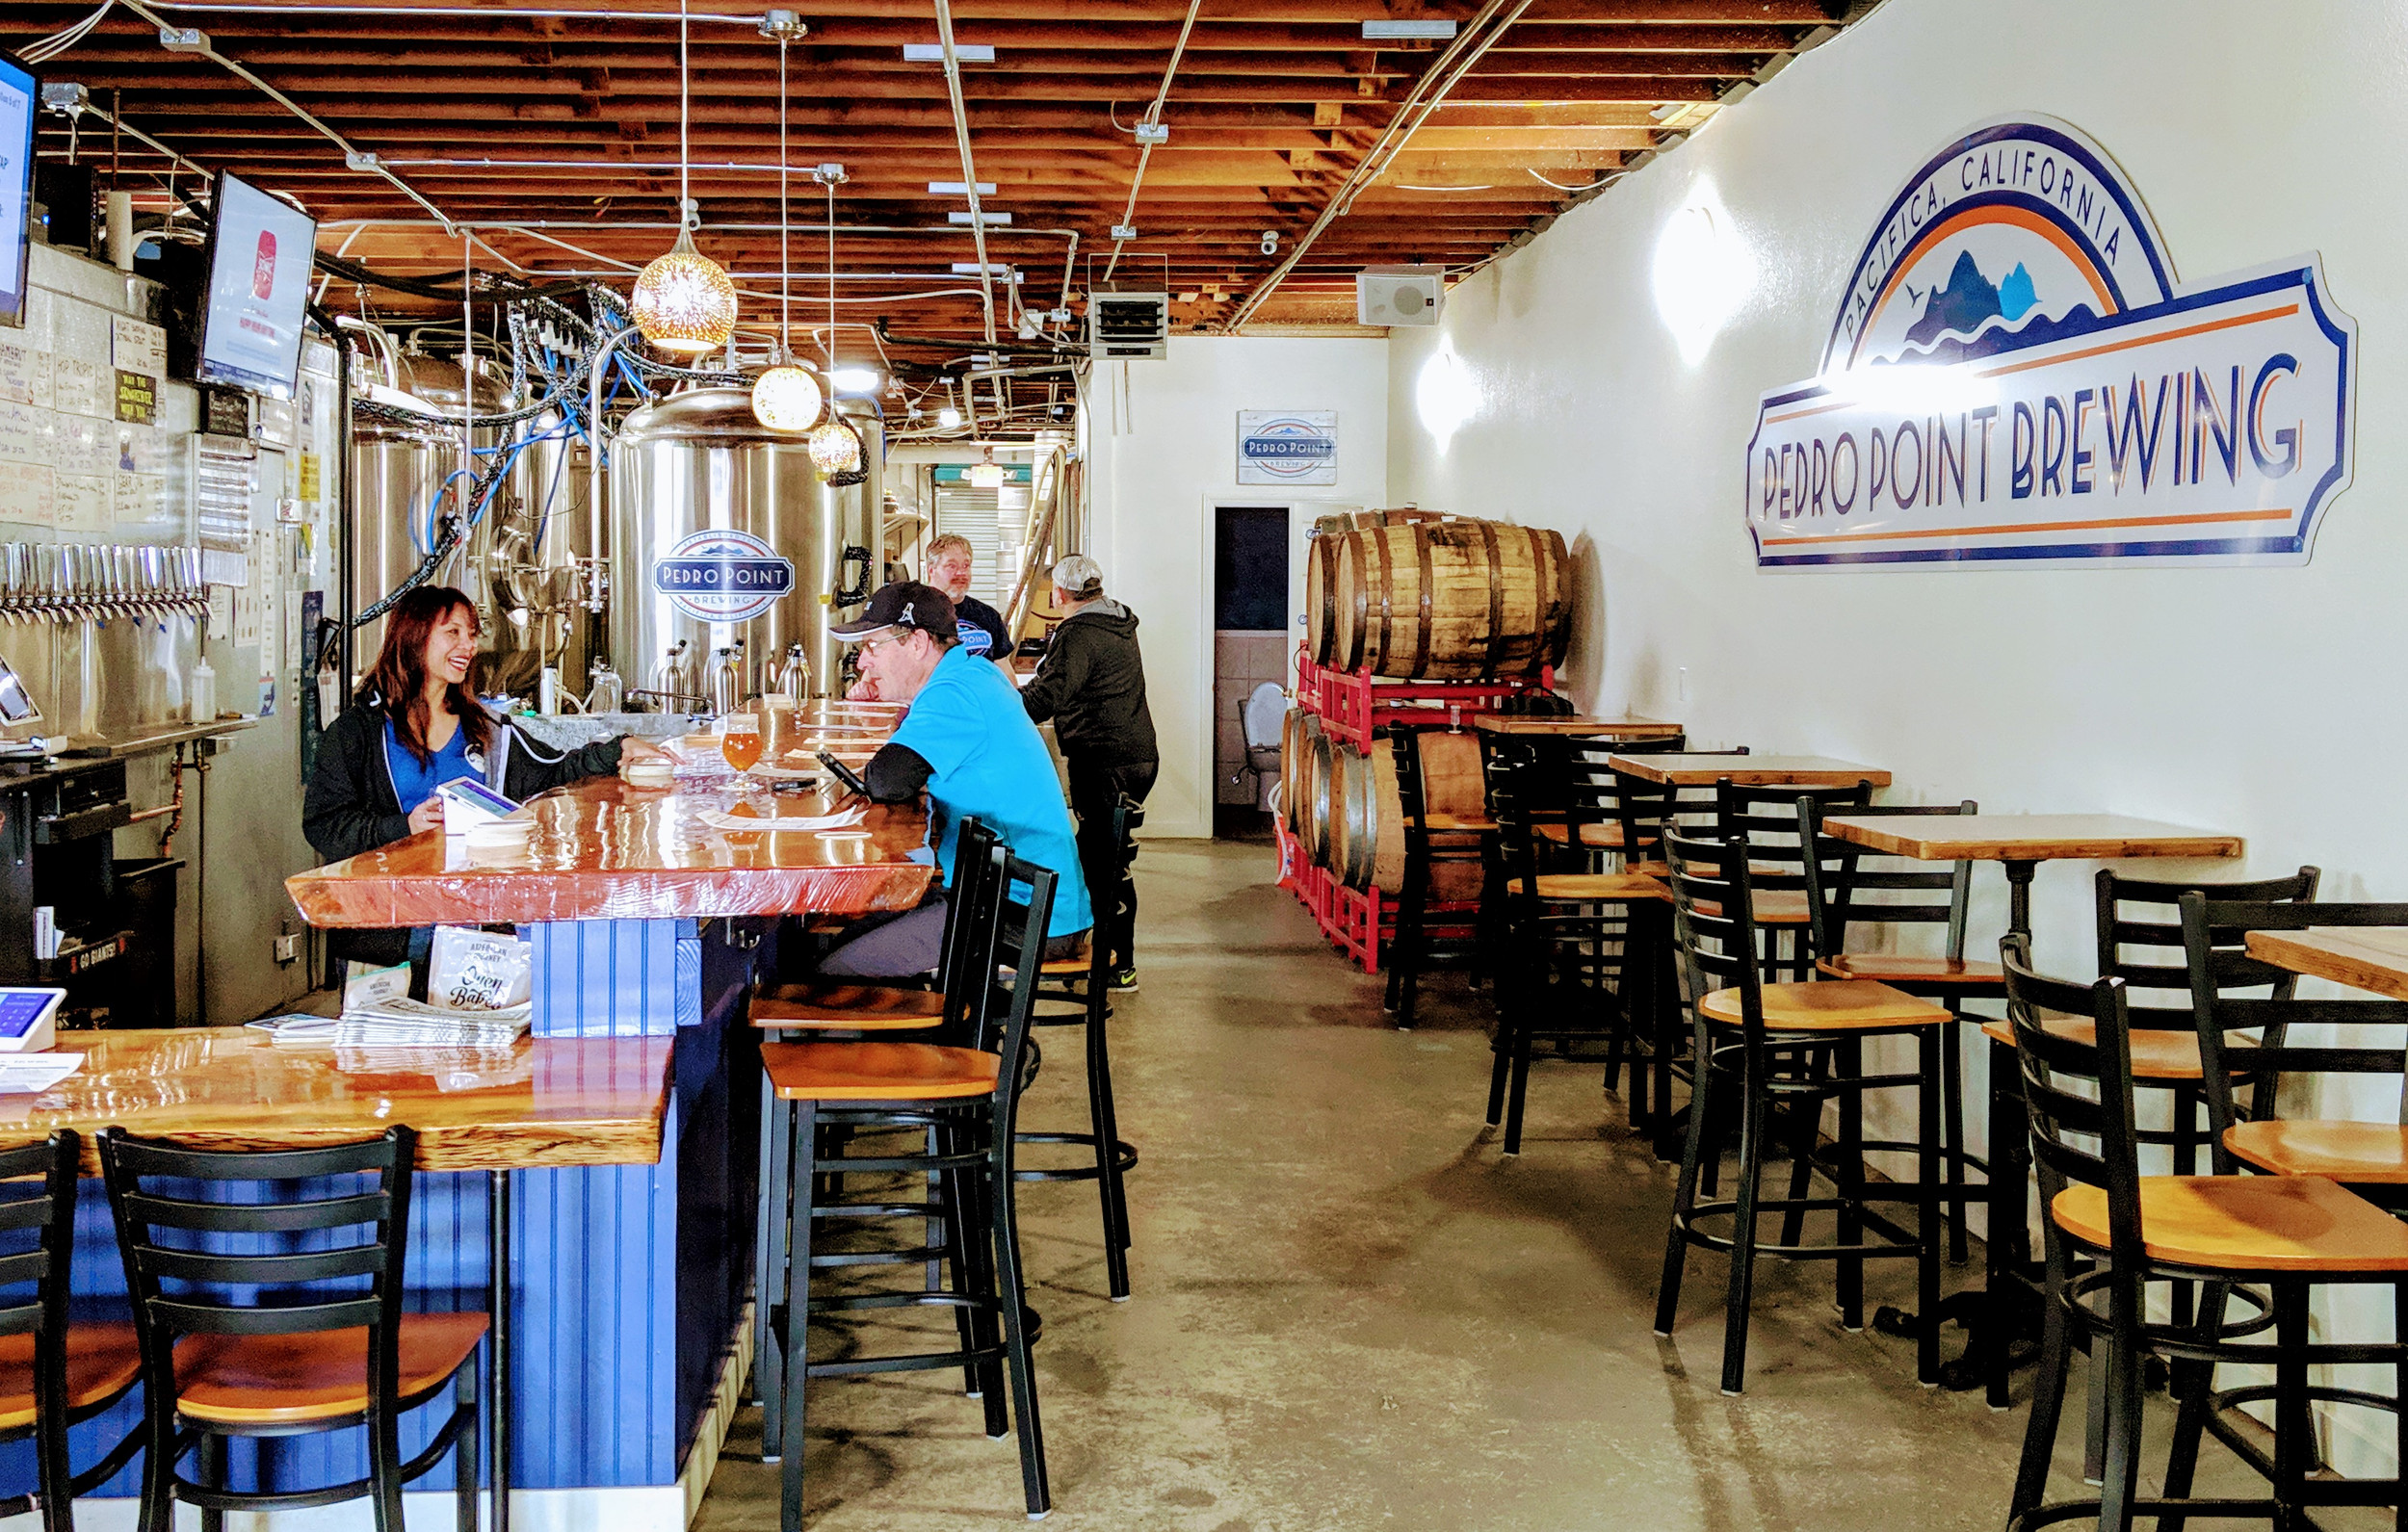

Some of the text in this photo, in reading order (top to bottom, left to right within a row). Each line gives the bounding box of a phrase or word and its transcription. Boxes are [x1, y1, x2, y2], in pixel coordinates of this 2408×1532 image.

[1845, 149, 2120, 343] PACIFICA, CALIFORNIA
[1764, 352, 2303, 521] PEDRO POINT BREWING
[1249, 442, 1328, 454] PEDRO POINT
[663, 566, 783, 584] PEDRO POINT
[694, 595, 750, 604] BREWING
